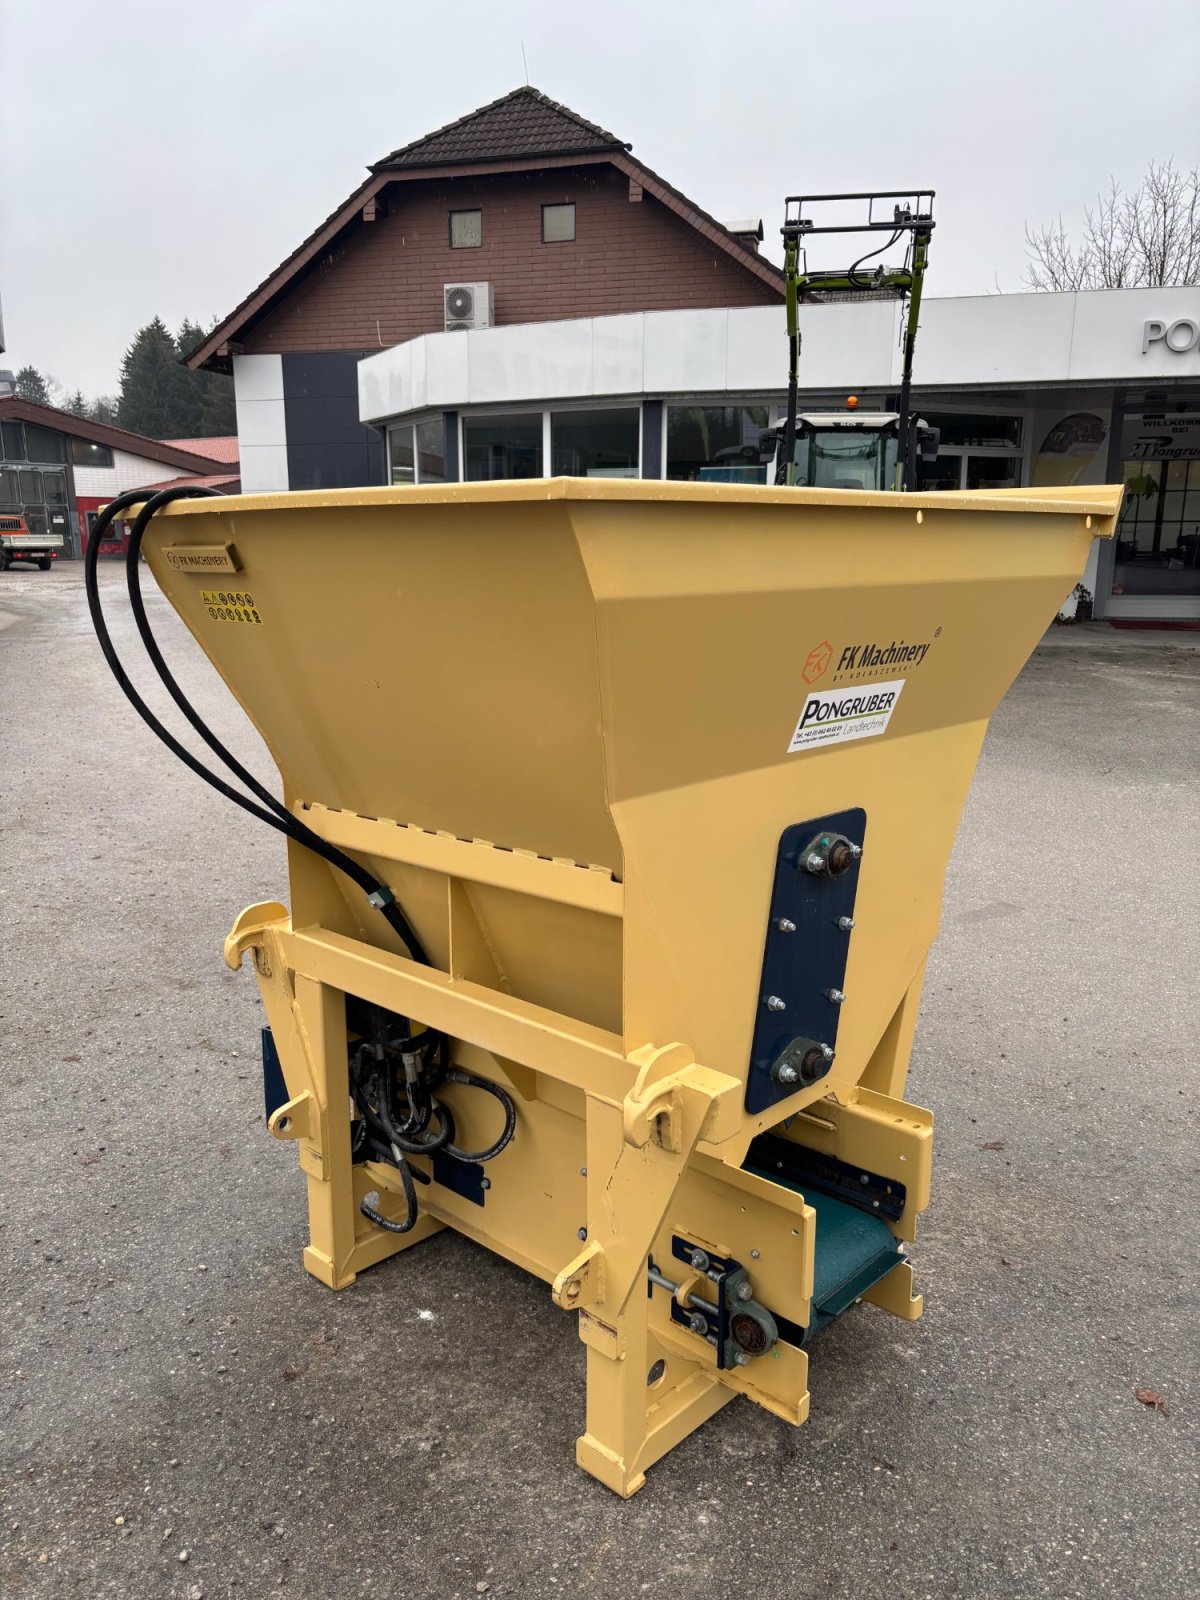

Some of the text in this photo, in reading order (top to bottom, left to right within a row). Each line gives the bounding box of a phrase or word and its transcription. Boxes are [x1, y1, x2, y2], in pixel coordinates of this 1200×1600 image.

[1142, 319, 1200, 354] PO
[837, 640, 930, 671] FK Machinery
[843, 716, 886, 735] Landtechnik
